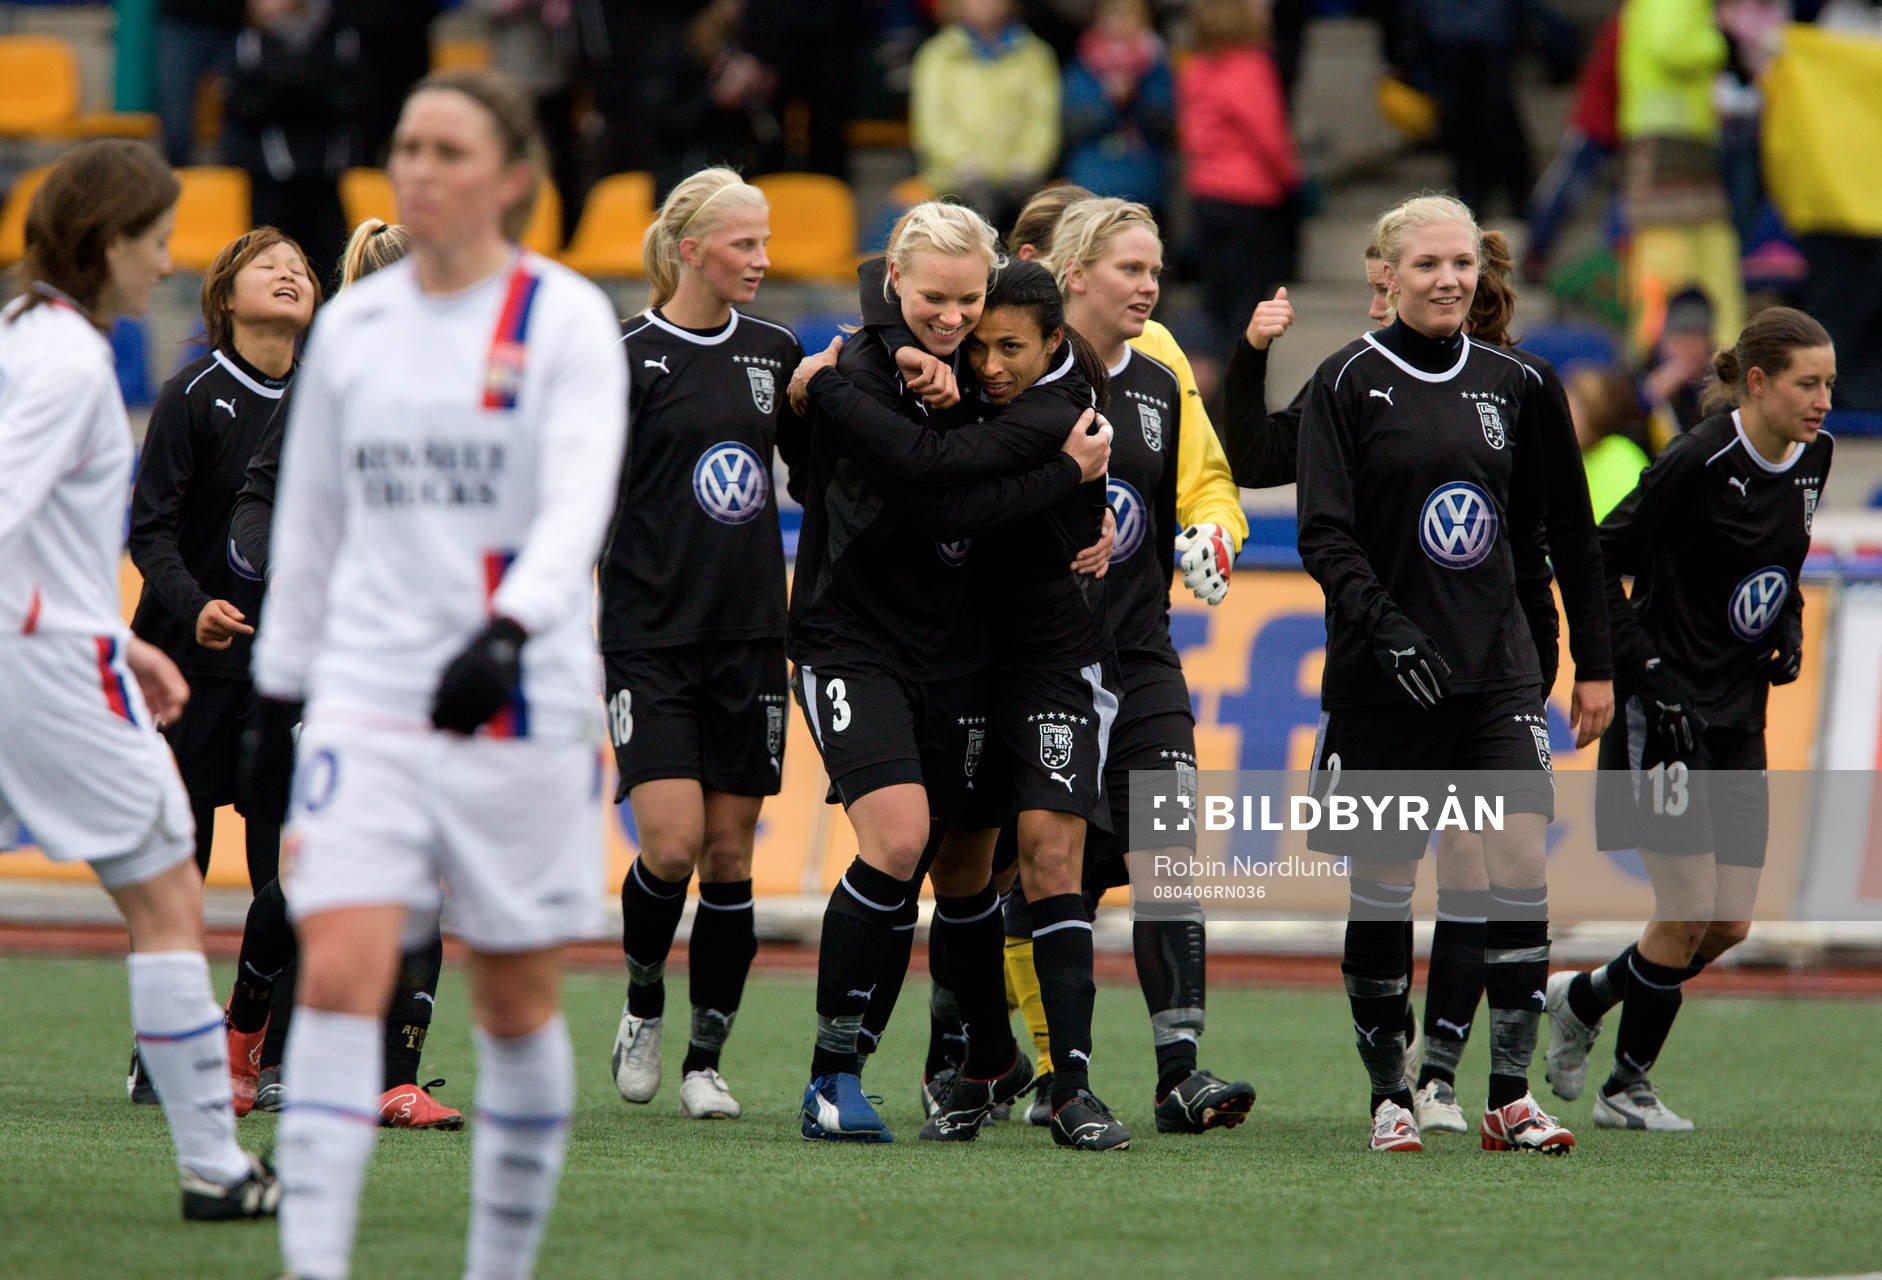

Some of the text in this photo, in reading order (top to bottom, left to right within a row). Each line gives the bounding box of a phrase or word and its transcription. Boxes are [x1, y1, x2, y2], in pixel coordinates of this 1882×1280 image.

[609, 688, 634, 748] 18
[826, 678, 852, 732] 3
[1647, 760, 1689, 816] 13
